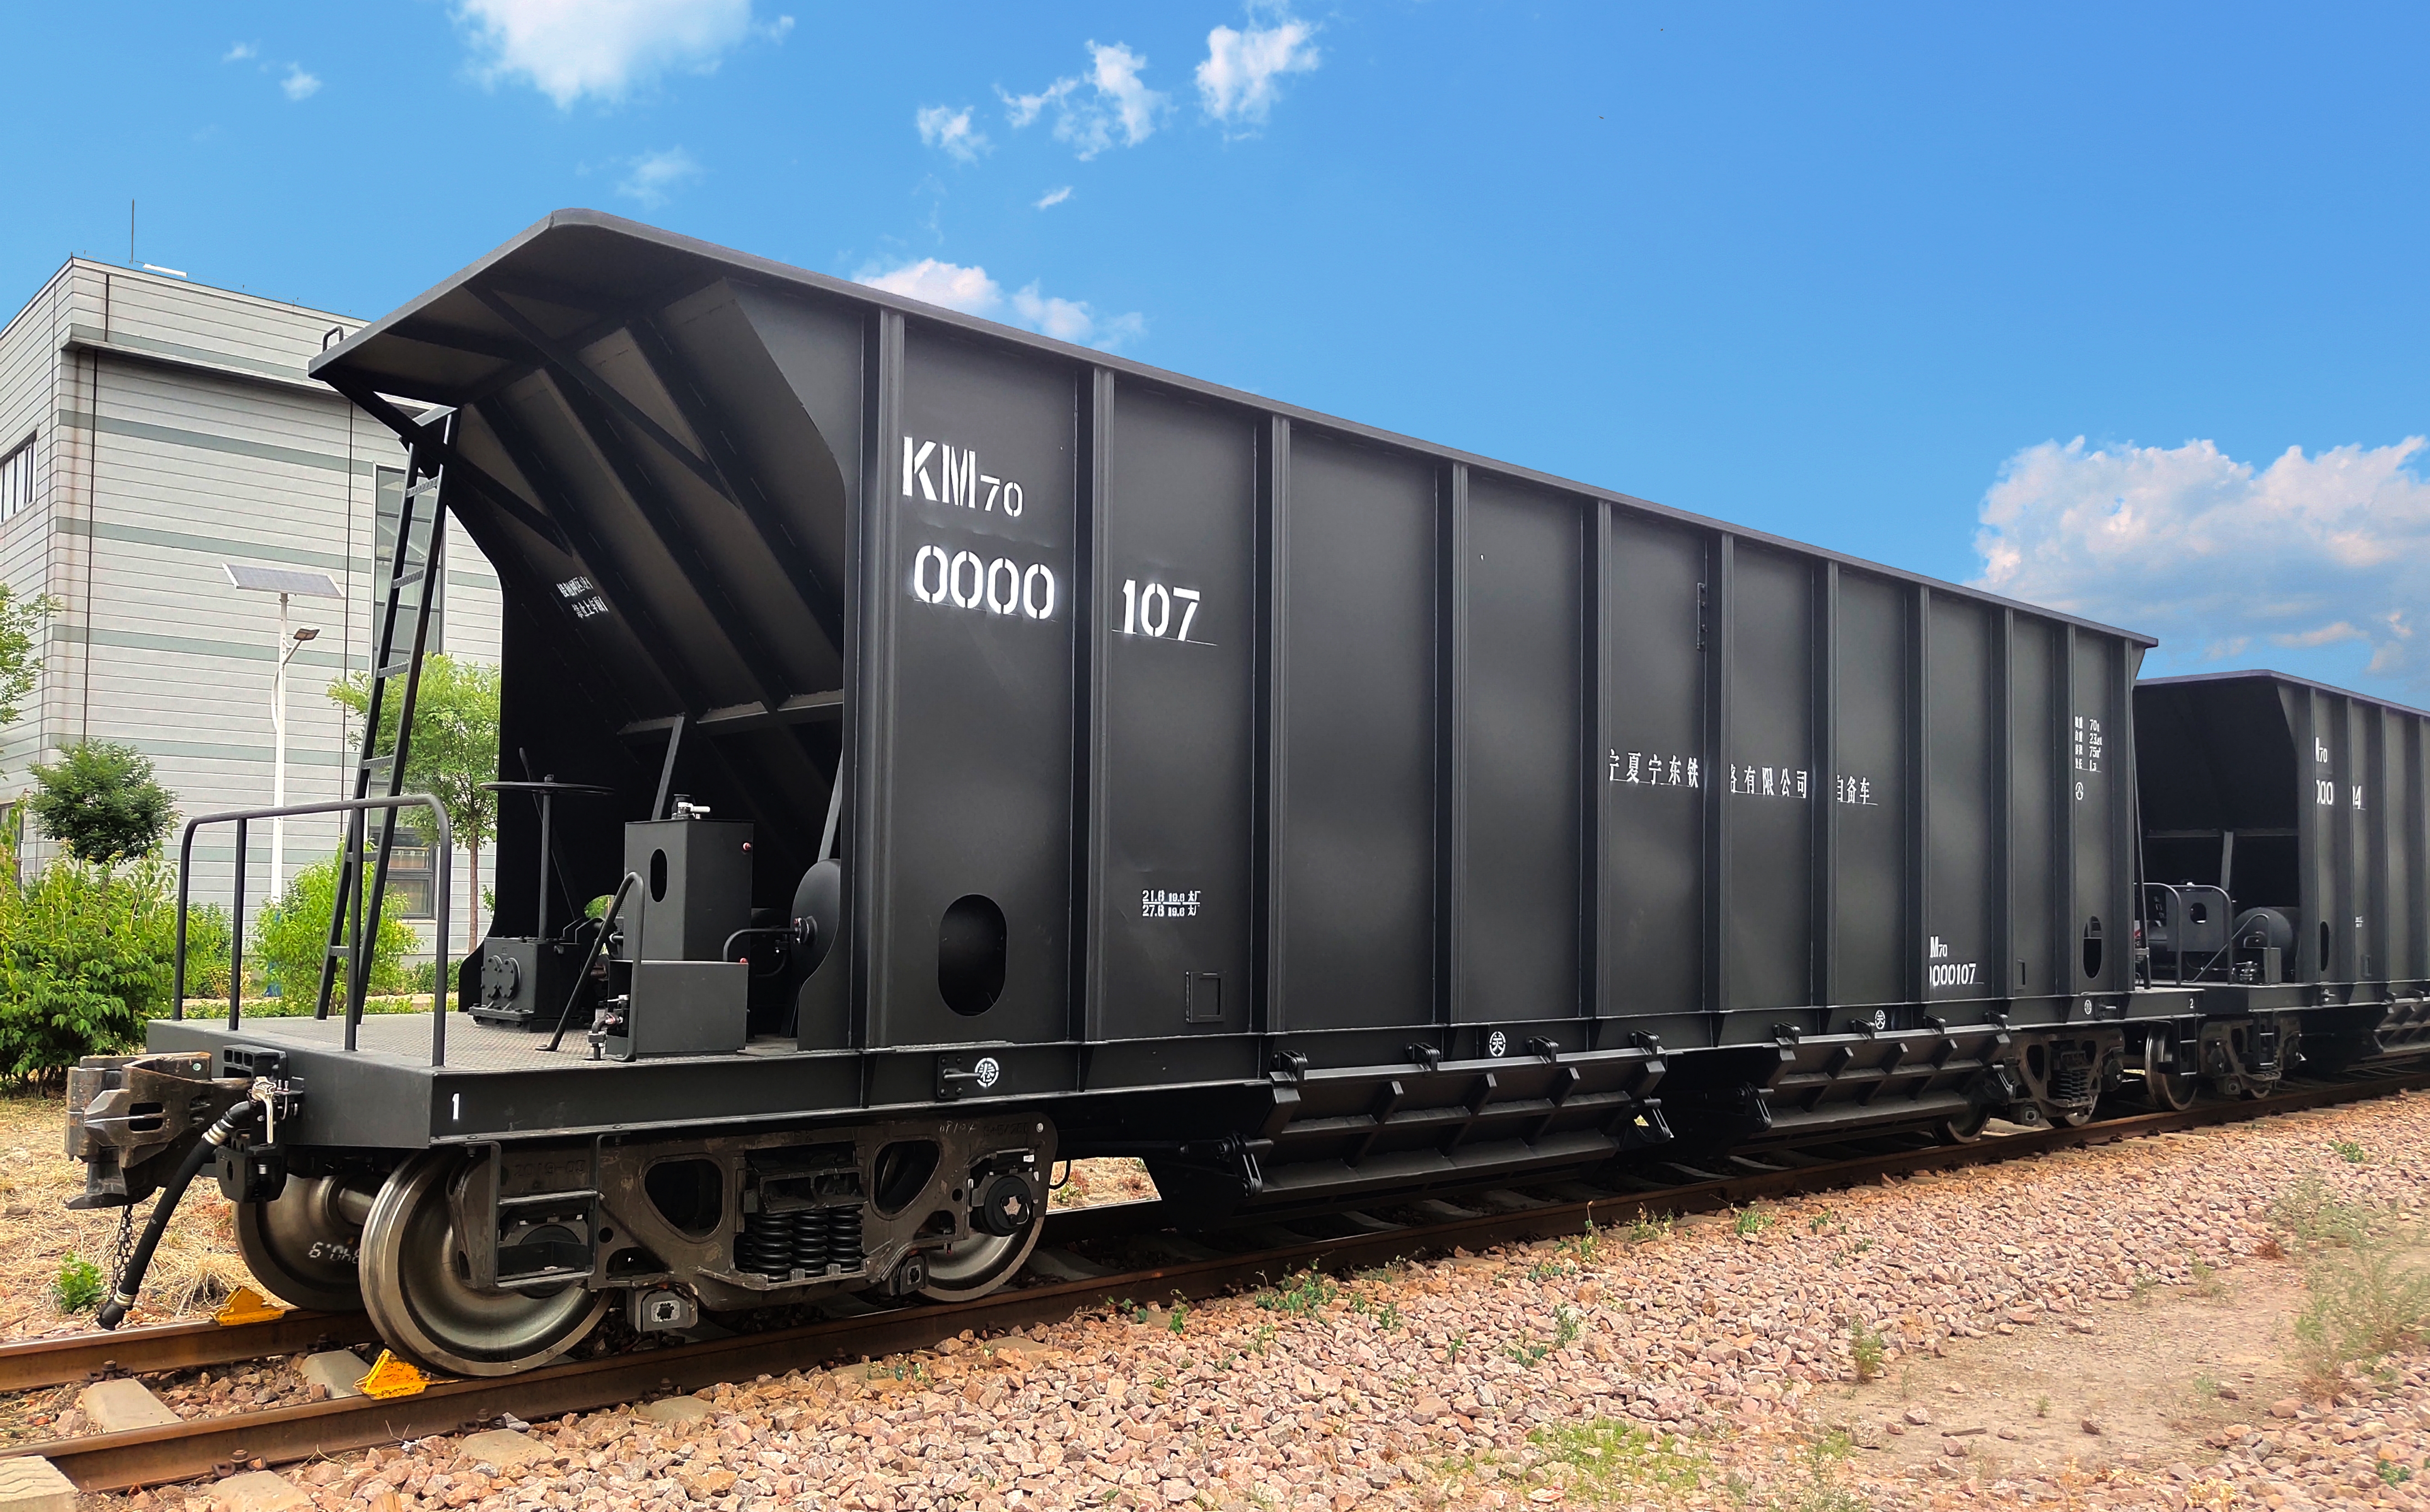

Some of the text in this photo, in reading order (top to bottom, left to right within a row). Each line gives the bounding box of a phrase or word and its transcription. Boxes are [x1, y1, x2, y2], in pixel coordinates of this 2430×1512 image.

[914, 545, 1200, 641] 0000 107
[2189, 998, 2194, 1009] 2
[452, 1093, 459, 1120] 1
